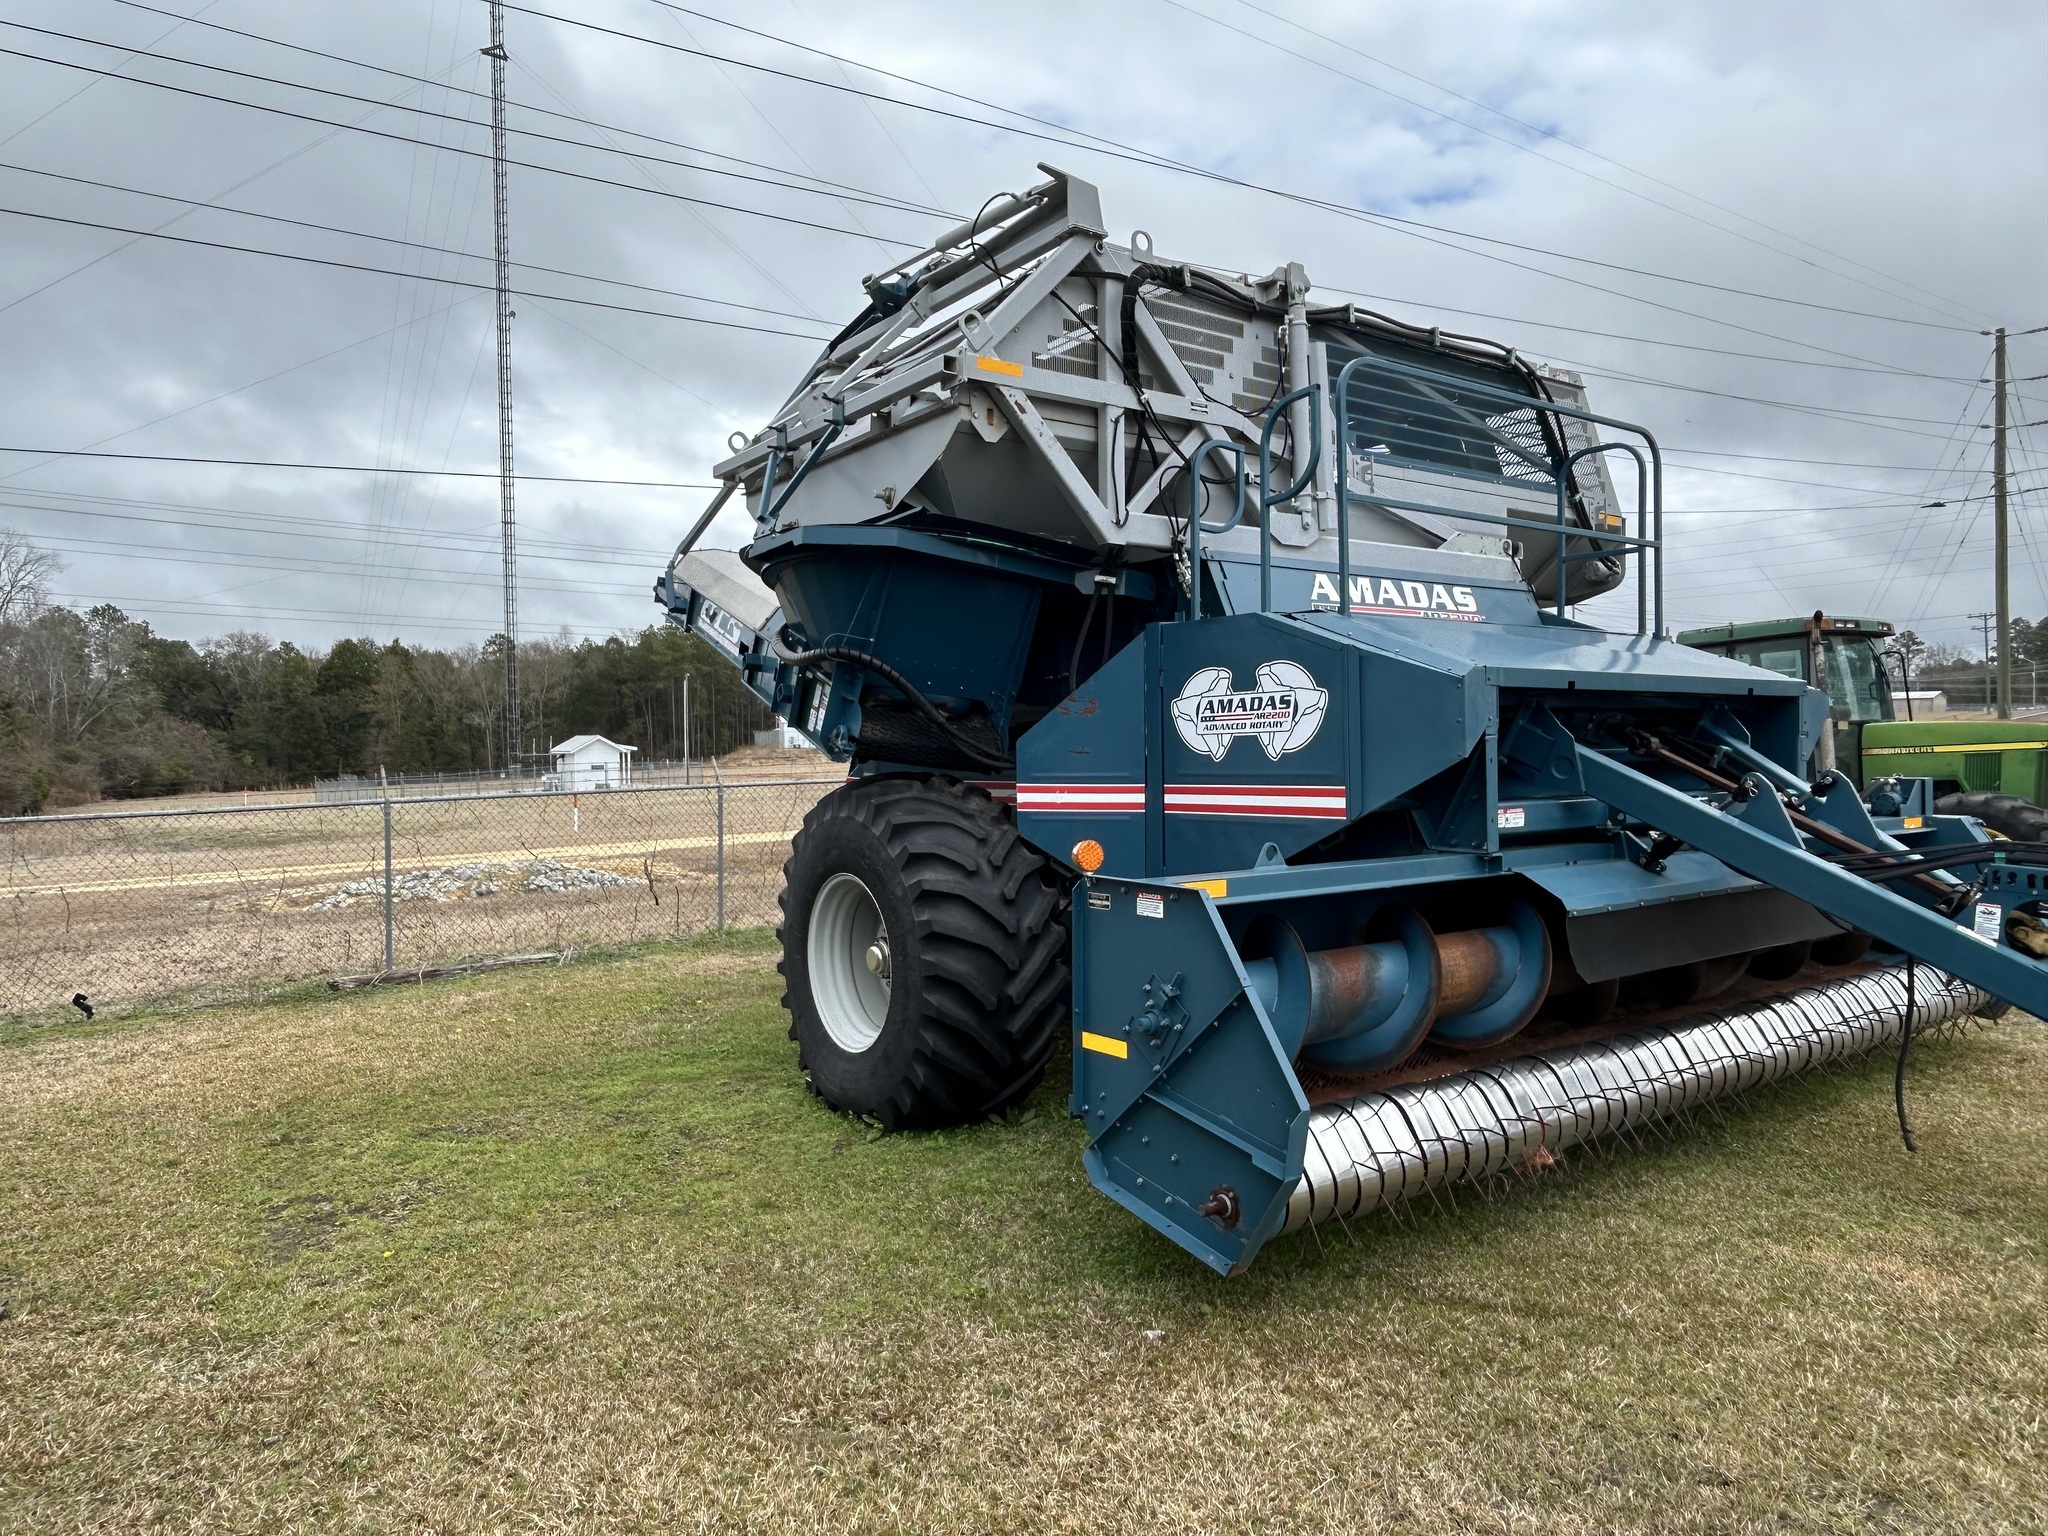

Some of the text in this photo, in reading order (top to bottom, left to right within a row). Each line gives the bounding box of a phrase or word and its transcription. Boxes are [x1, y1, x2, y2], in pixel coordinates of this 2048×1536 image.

[1311, 573, 1477, 612] AMADAS
[1202, 694, 1292, 714] AMADAS
[1253, 711, 1291, 720] AR2200
[1203, 720, 1284, 731] ADVANCED ROTARY
